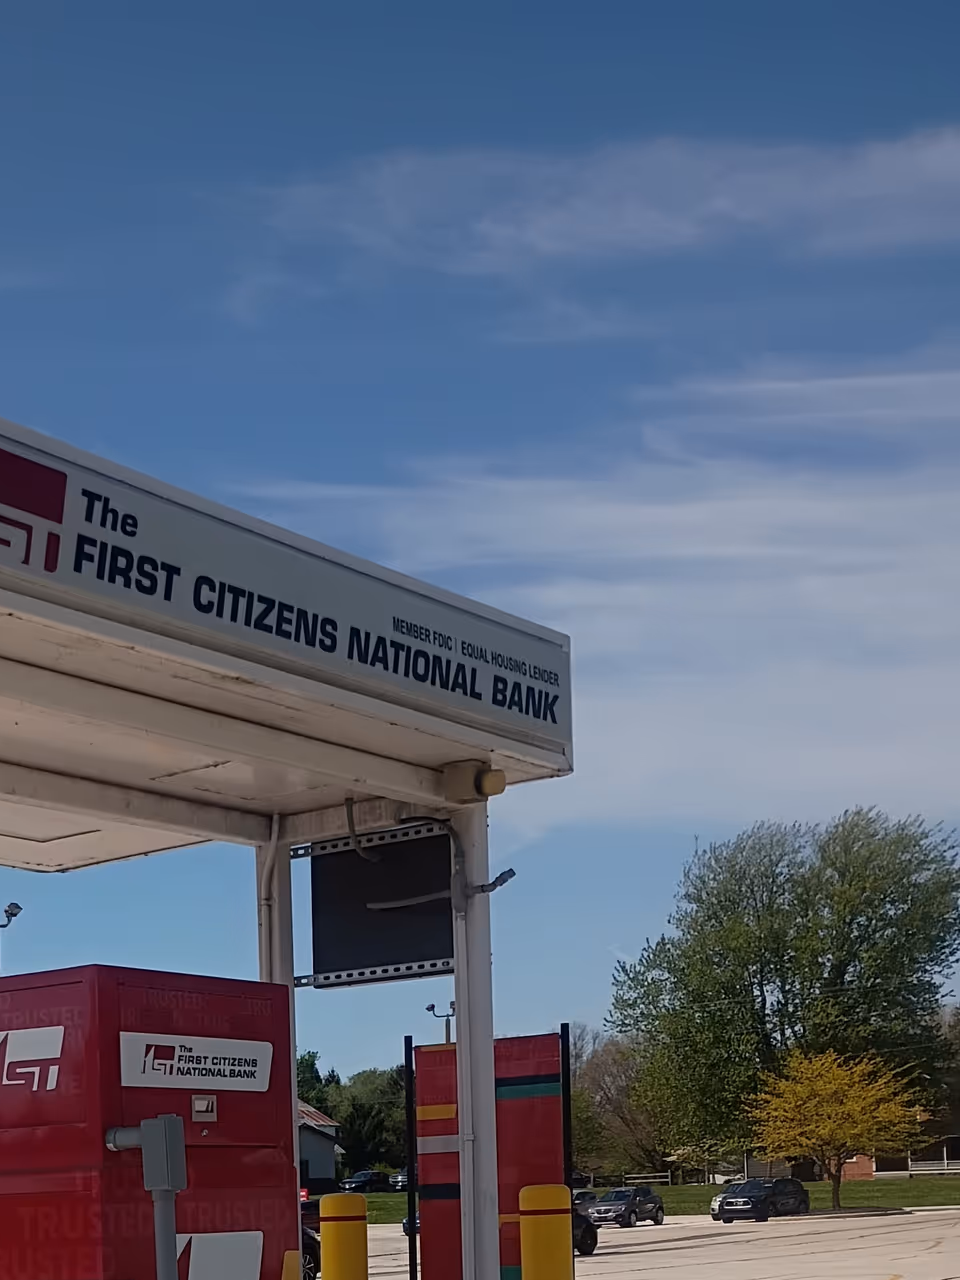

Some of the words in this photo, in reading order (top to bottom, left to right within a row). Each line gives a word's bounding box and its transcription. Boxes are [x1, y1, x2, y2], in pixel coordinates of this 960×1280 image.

[80, 487, 138, 537] The
[73, 533, 181, 602] FIRST
[193, 575, 338, 654] CITIZENS
[347, 625, 482, 700] NATIONAL
[492, 674, 560, 724] BANK
[392, 616, 432, 644] MEMBER
[433, 630, 453, 651] FDIC
[461, 641, 489, 664] EQUAL
[491, 653, 528, 677] HOUSING
[528, 663, 560, 687] LENDER
[177, 1055, 209, 1066] FIRST
[211, 1056, 258, 1068] CITIZENS
[178, 1044, 193, 1053] The
[176, 1066, 228, 1078] NATIONAL
[228, 1069, 257, 1079] BANK
